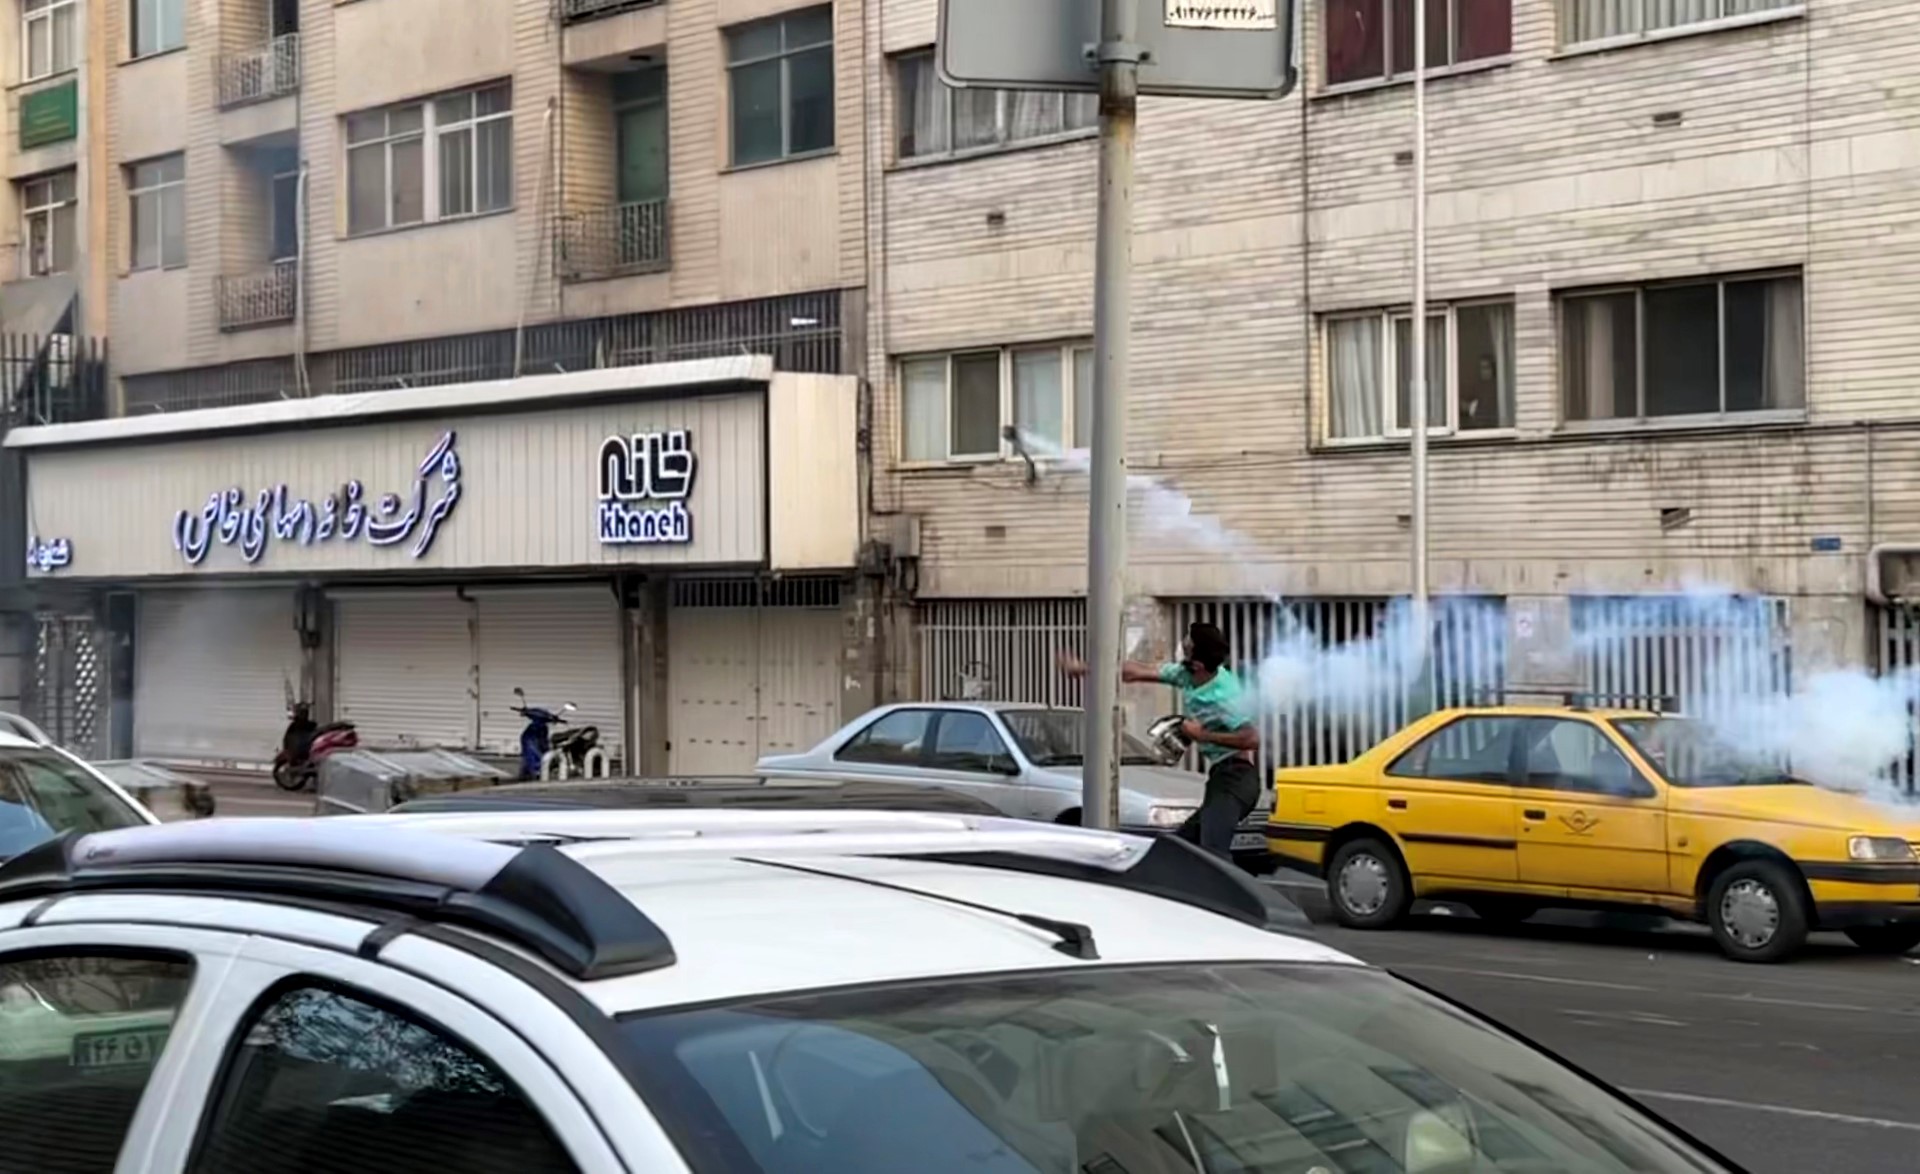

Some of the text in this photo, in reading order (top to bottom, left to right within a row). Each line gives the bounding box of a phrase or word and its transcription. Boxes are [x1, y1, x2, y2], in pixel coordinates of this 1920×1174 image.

[365, 431, 461, 558] شرکت
[598, 431, 695, 500] خانه
[598, 501, 690, 543] khaneh
